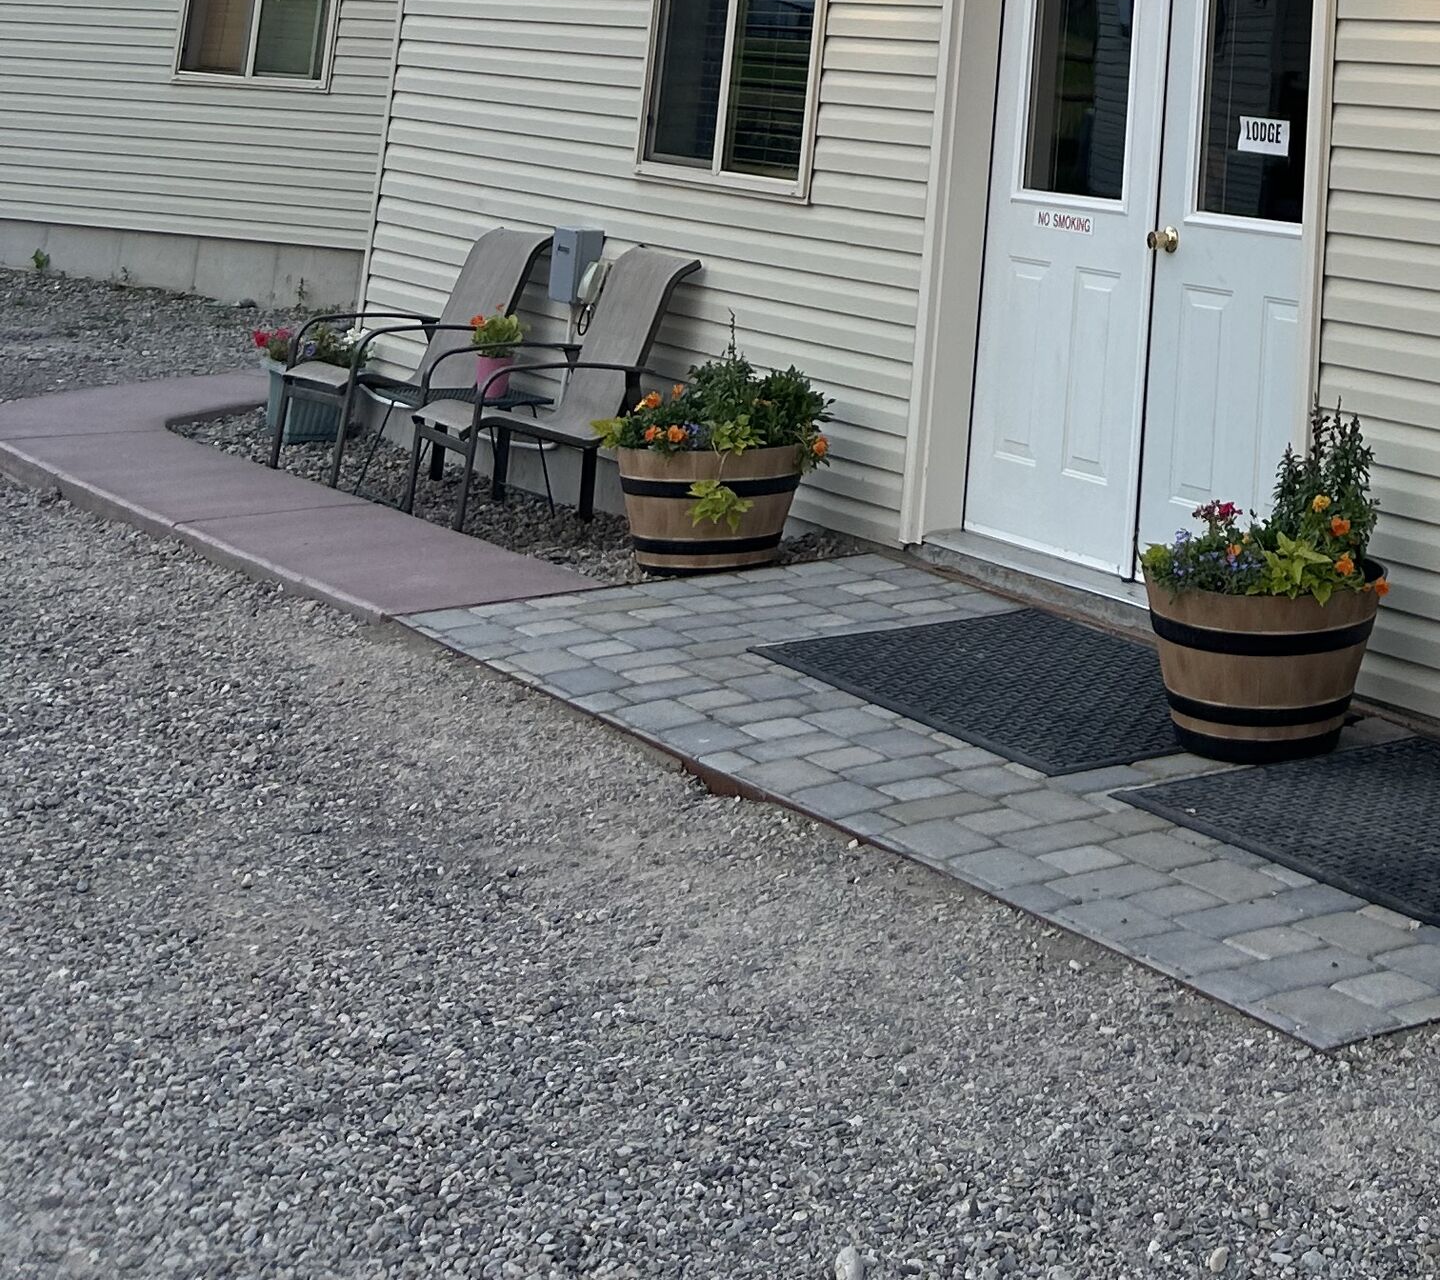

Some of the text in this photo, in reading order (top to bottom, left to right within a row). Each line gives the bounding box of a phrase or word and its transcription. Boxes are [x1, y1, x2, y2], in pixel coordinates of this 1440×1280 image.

[1246, 120, 1282, 144] LODGE
[1038, 211, 1091, 233] NO SMOKING
